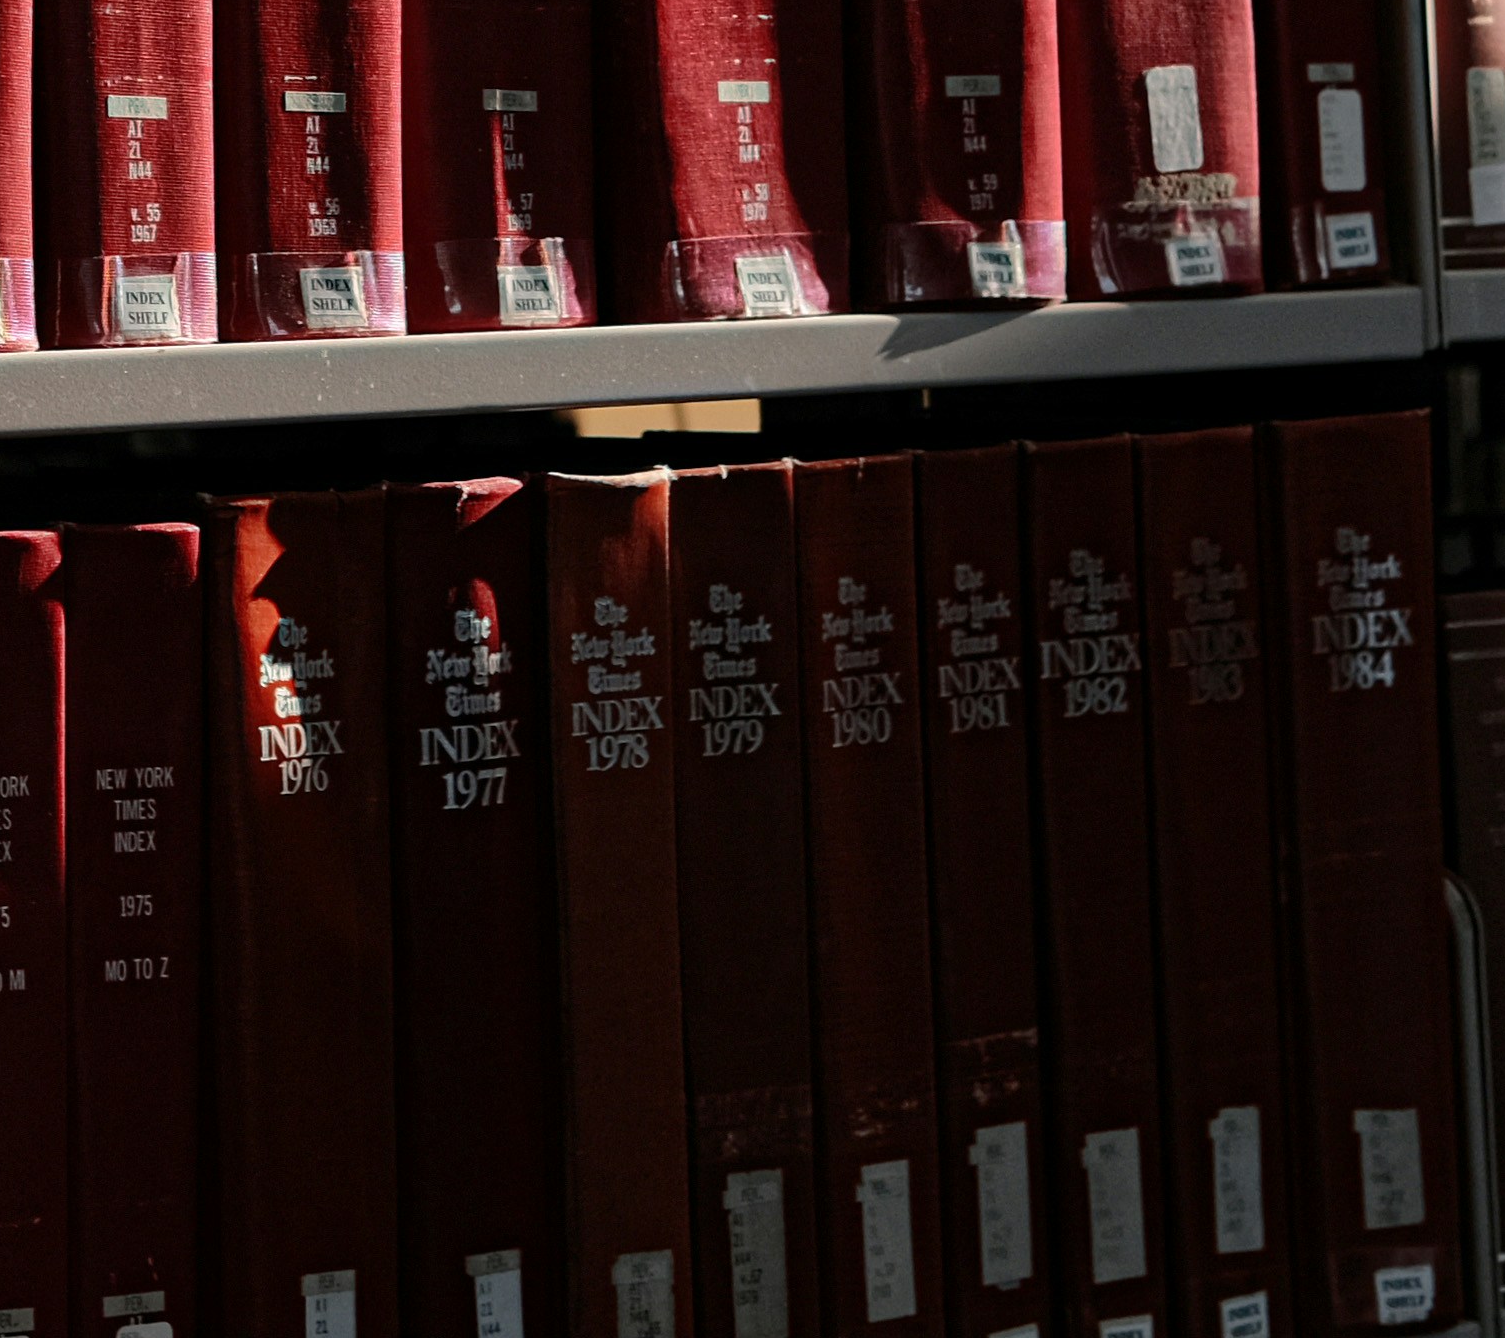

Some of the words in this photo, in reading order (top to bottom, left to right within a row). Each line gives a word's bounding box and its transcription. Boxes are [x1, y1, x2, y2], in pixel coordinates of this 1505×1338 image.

[1314, 610, 1413, 654] INDEX
[419, 720, 520, 766] INDEX
[442, 767, 507, 810] 1977
